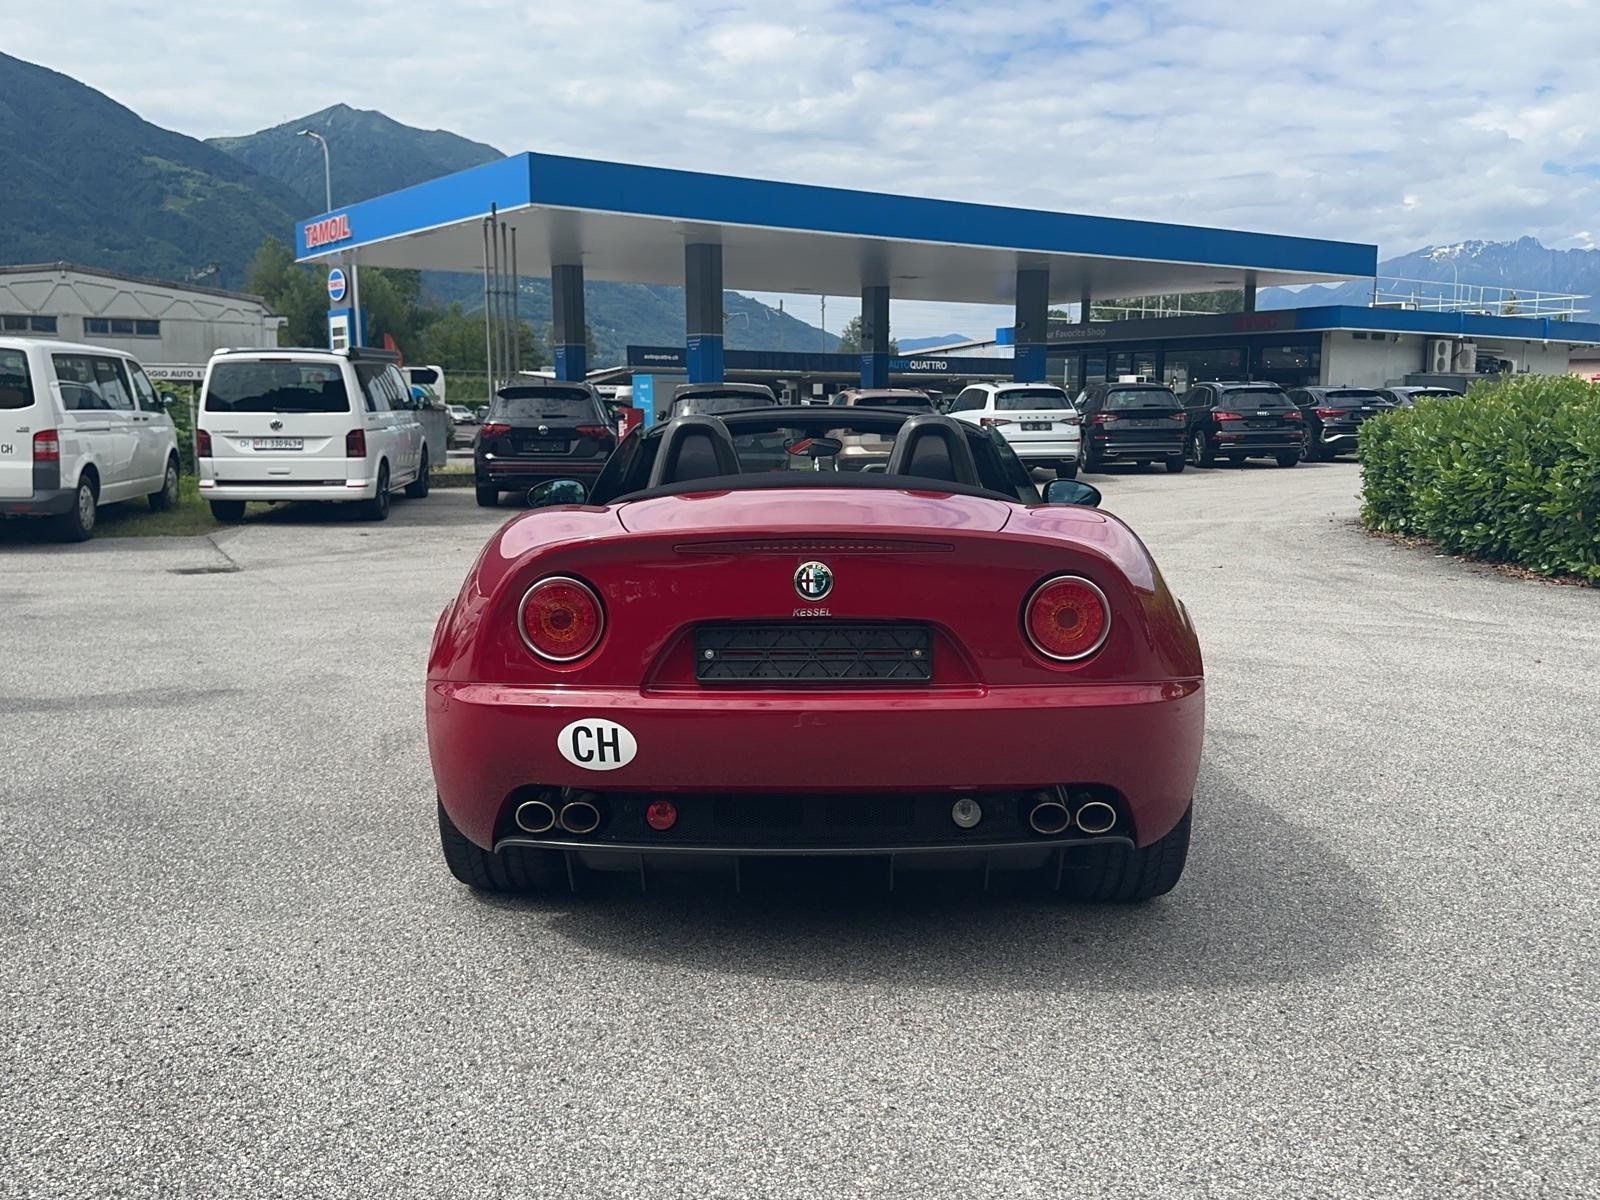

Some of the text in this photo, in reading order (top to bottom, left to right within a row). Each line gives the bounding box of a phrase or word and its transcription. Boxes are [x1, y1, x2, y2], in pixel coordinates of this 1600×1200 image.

[305, 215, 351, 247] TAMOIL
[1055, 329, 1085, 338] Favorite
[1086, 328, 1106, 337] Shop
[170, 370, 194, 378] AUTO
[1, 444, 13, 454] CH
[792, 608, 832, 617] KESSEL
[572, 726, 621, 762] CH
